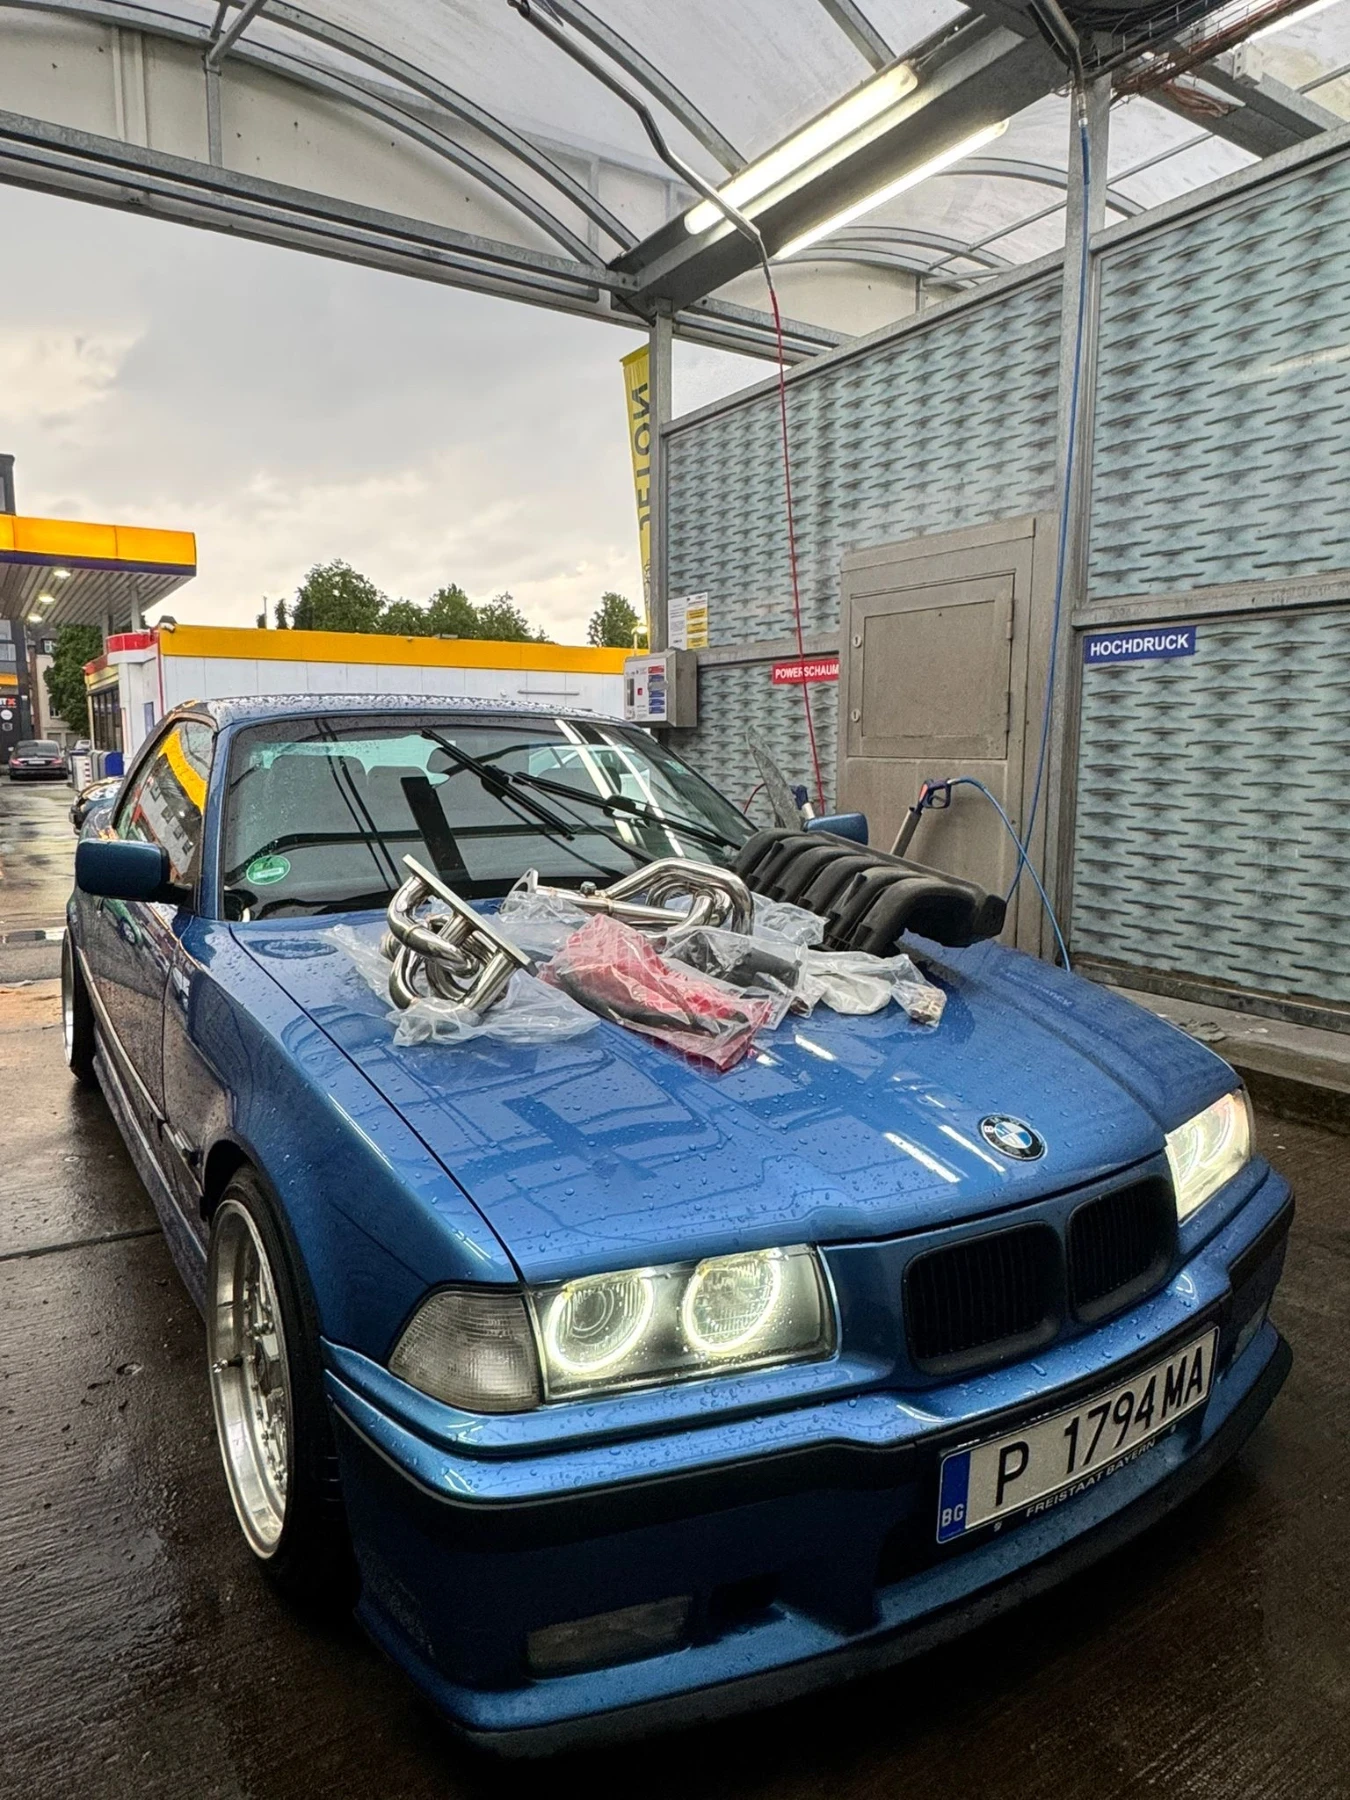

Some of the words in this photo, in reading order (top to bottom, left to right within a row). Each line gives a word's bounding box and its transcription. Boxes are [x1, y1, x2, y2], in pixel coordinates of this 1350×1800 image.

[1090, 633, 1189, 657] HOCHDRUCK
[775, 664, 839, 679] POWERSCHAUM
[996, 1440, 1029, 1507] P
[1026, 1471, 1103, 1517] FREISTAAT
[1106, 1438, 1156, 1475] BAYERN
[942, 1503, 965, 1528] BG
